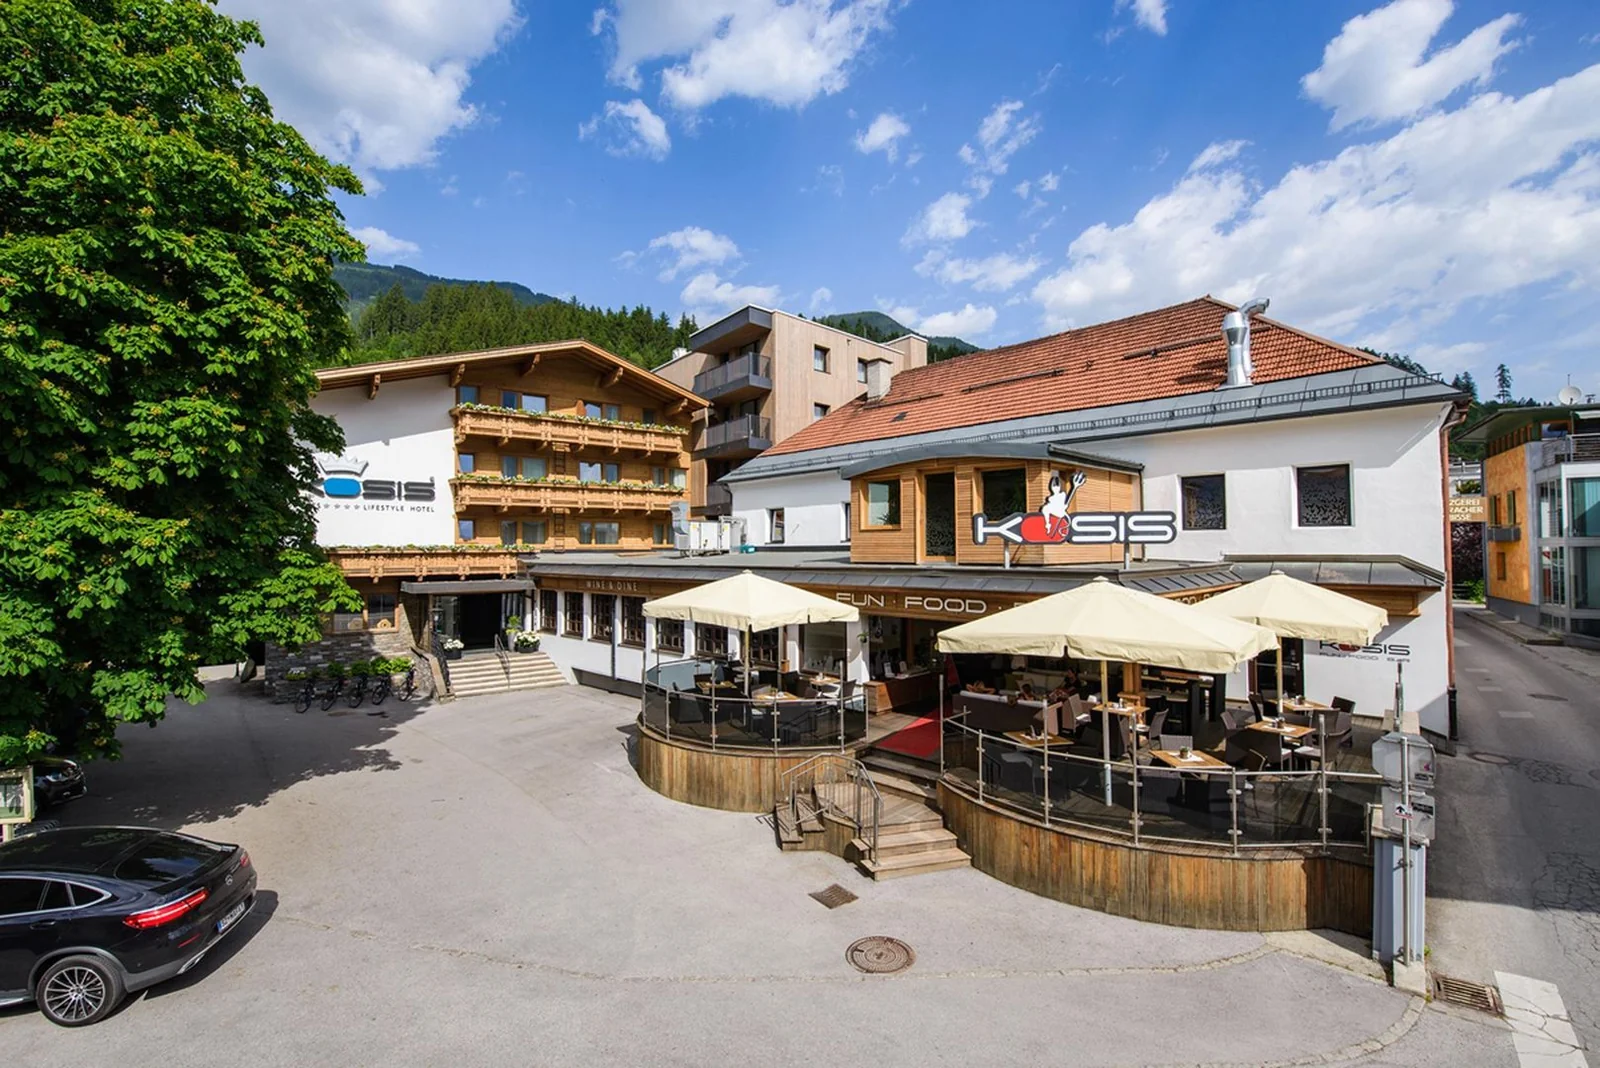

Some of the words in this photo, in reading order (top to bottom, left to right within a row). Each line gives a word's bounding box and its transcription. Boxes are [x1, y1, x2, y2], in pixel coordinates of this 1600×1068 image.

[363, 504, 405, 512] LIFESTYLE
[410, 505, 435, 513] HOTEL
[973, 512, 1178, 545] KOSIS
[586, 580, 606, 590] WINE
[616, 581, 638, 592] DINE
[836, 592, 885, 607] FUN
[904, 596, 988, 614] FOOD
